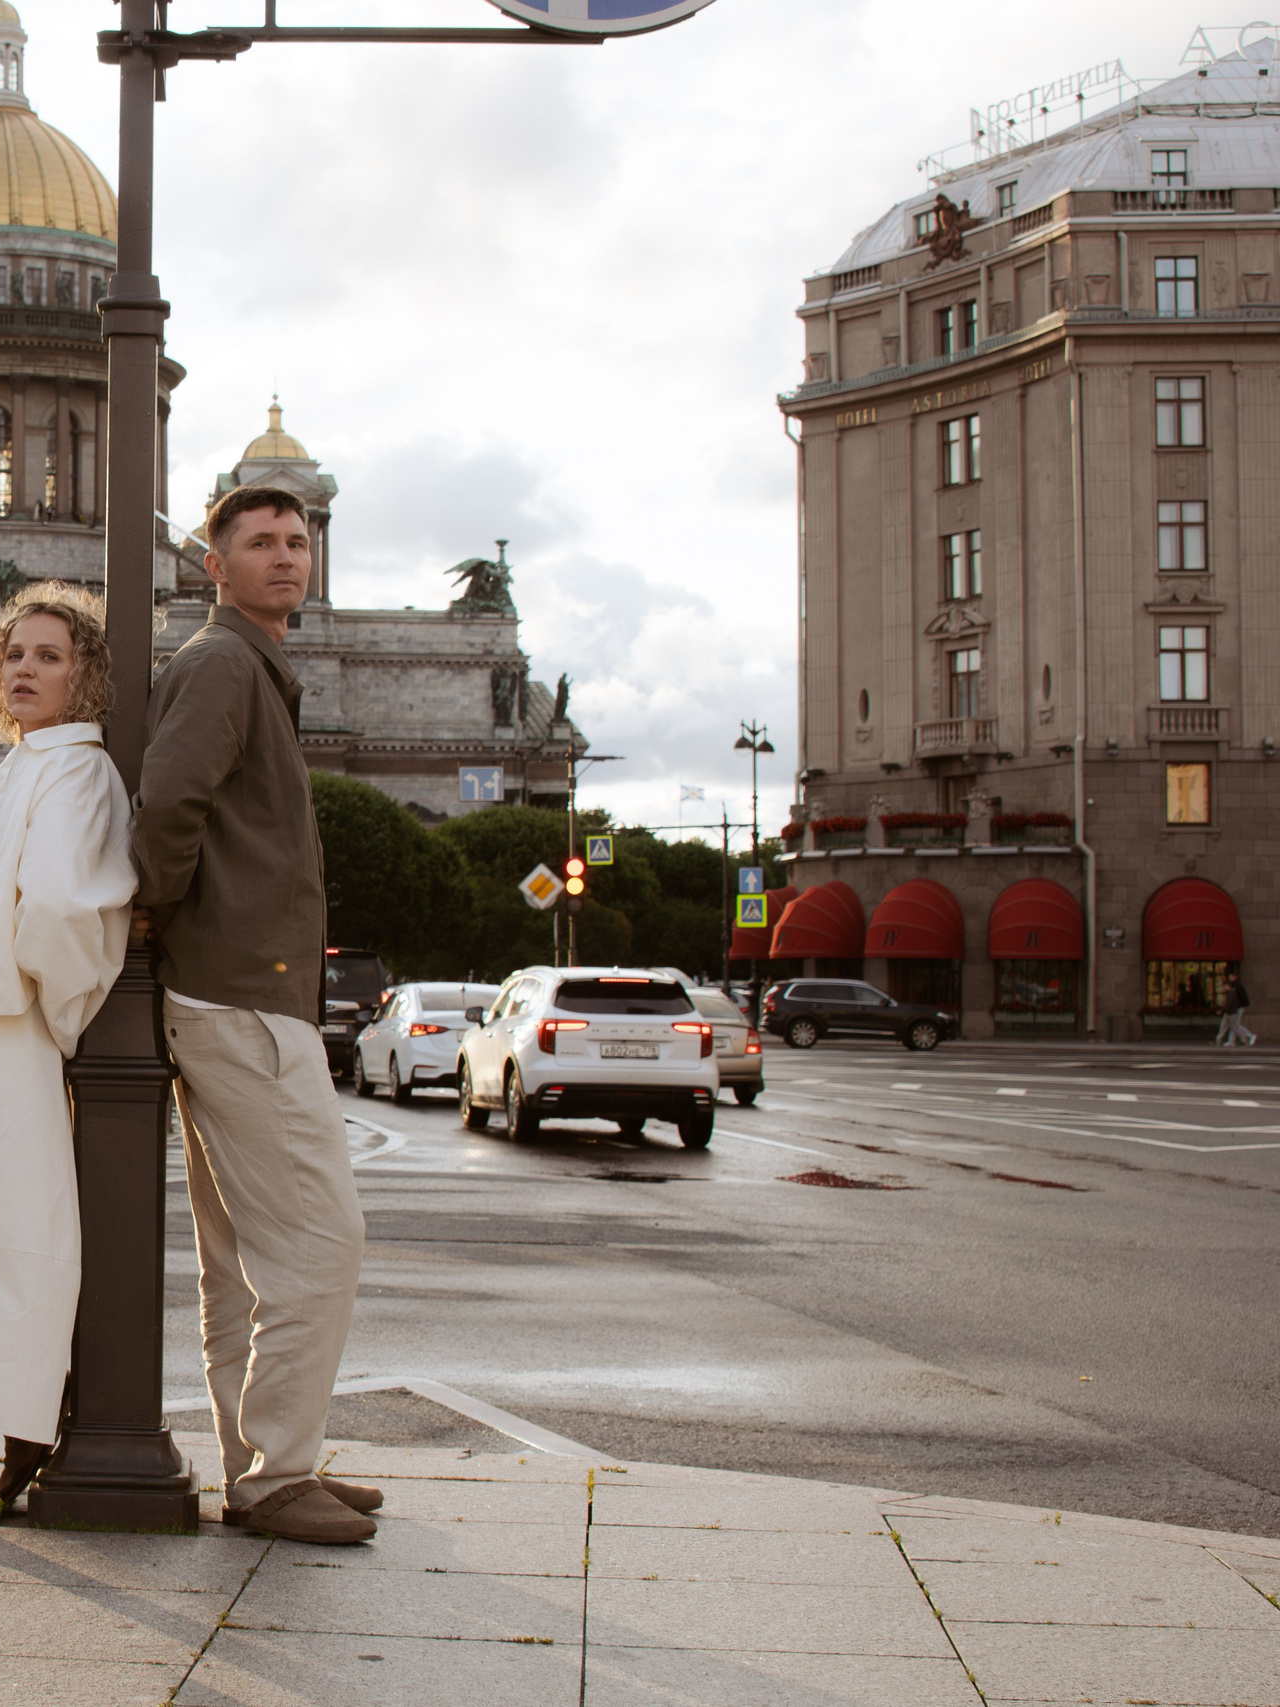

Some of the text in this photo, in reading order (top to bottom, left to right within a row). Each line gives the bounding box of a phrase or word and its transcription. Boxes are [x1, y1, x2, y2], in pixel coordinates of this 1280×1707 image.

[987, 57, 1125, 125] ГОСТИНИЦА
[836, 406, 877, 428] HOTEL
[911, 379, 992, 413] ASTORIA
